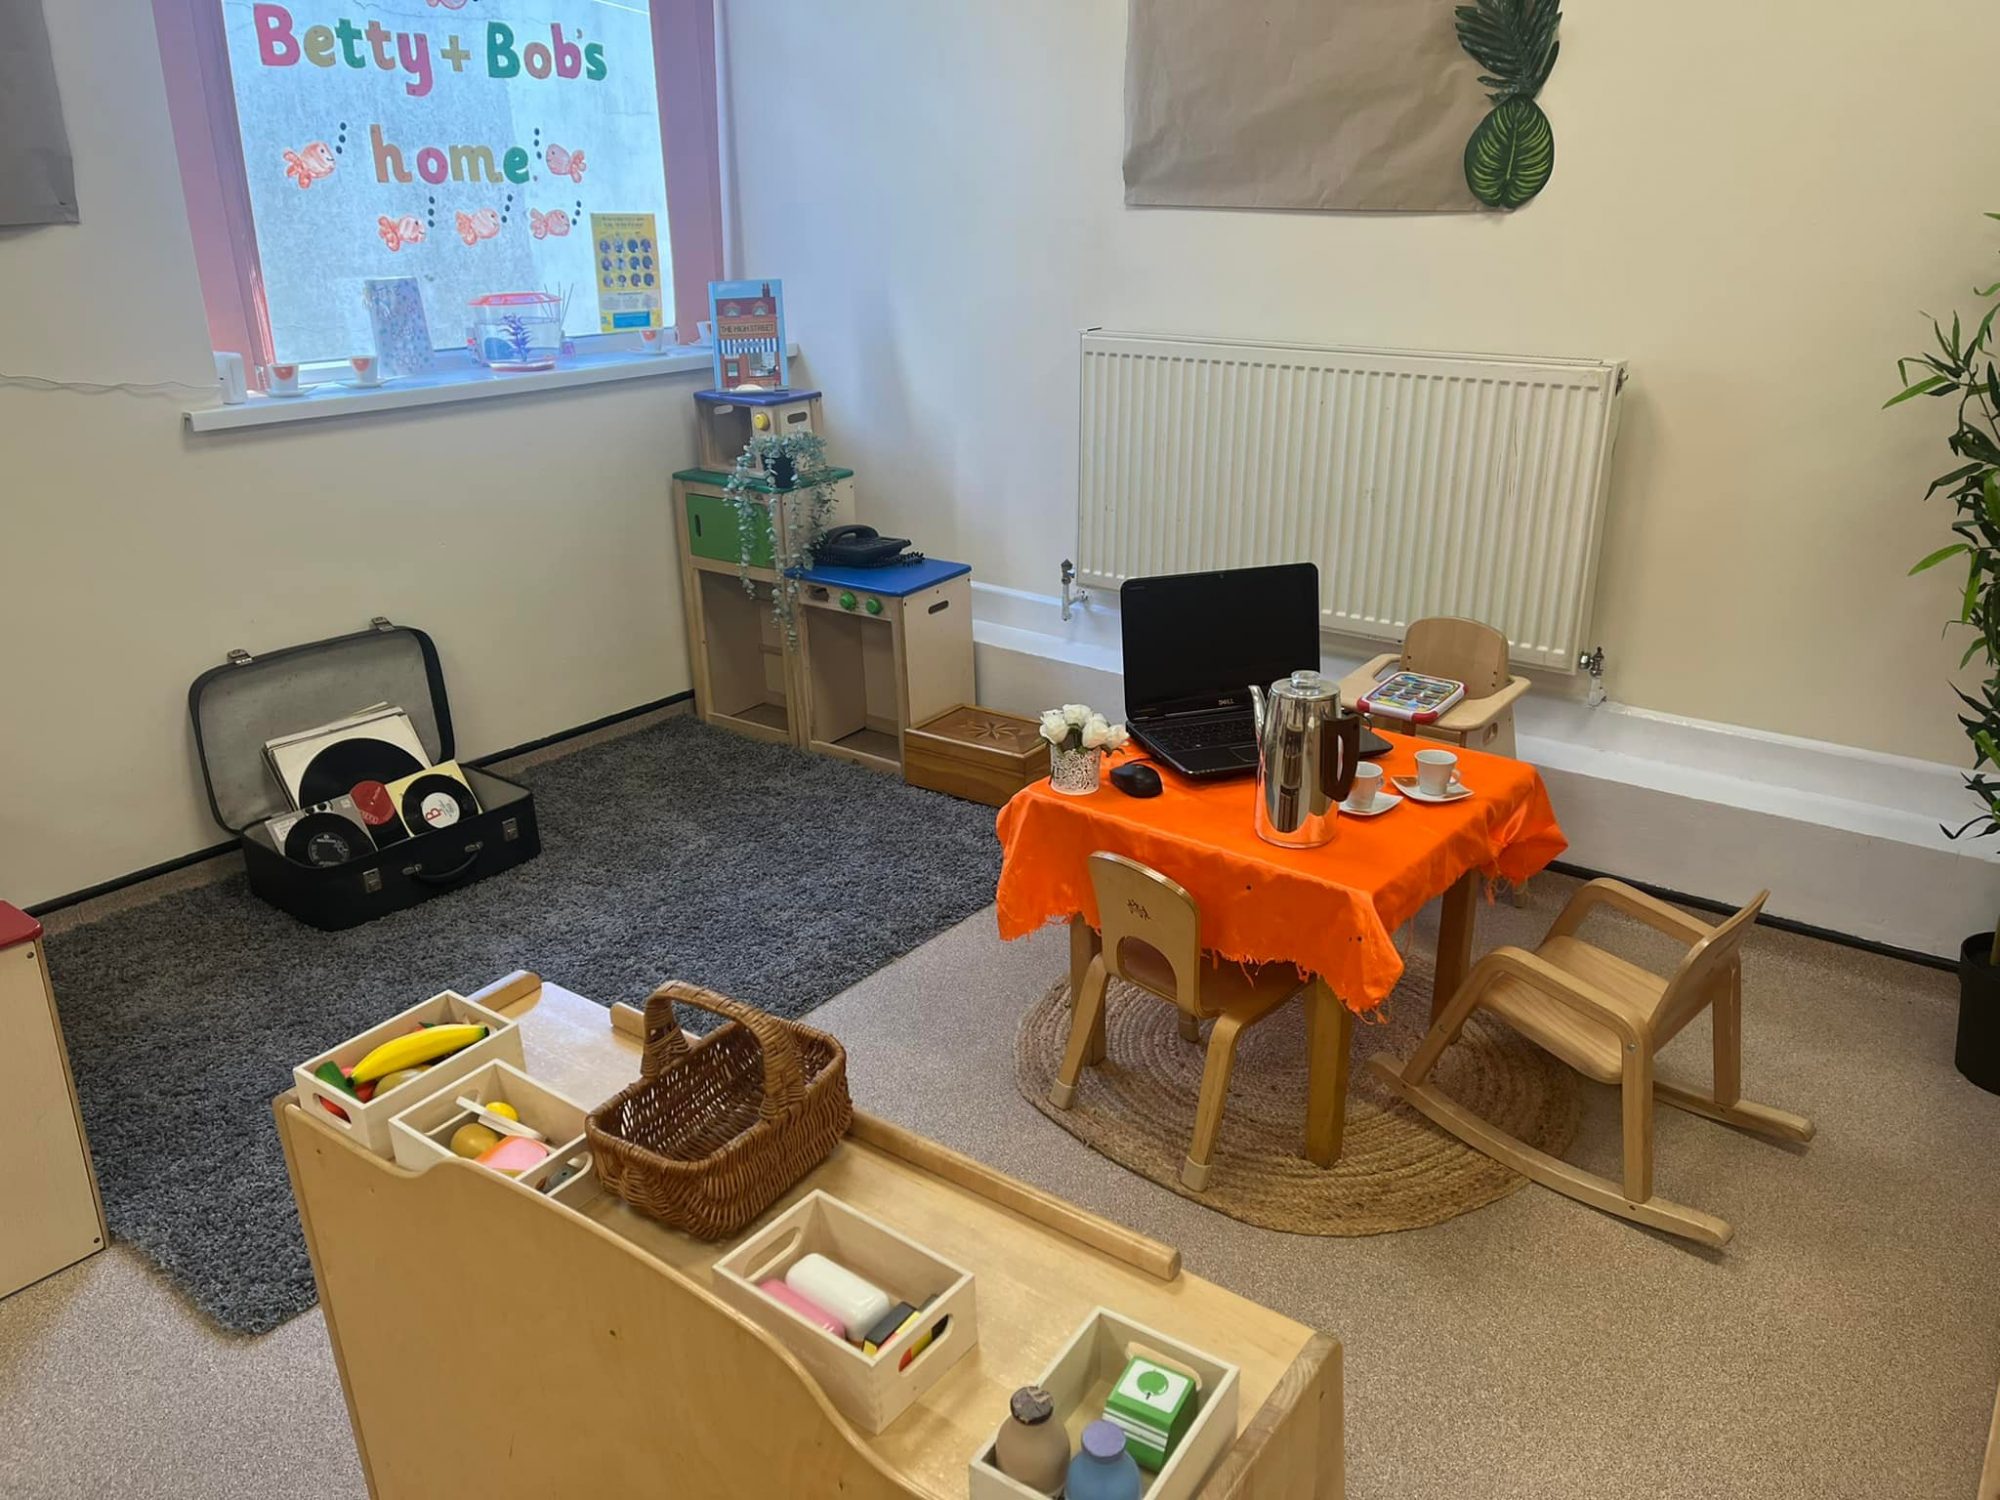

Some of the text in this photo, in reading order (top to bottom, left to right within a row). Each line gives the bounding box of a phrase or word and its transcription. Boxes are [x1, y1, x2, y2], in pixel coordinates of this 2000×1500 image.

[253, 3, 433, 97] Betty
[487, 21, 607, 81] Bob's
[720, 325, 733, 333] THE
[749, 323, 774, 332] STREET
